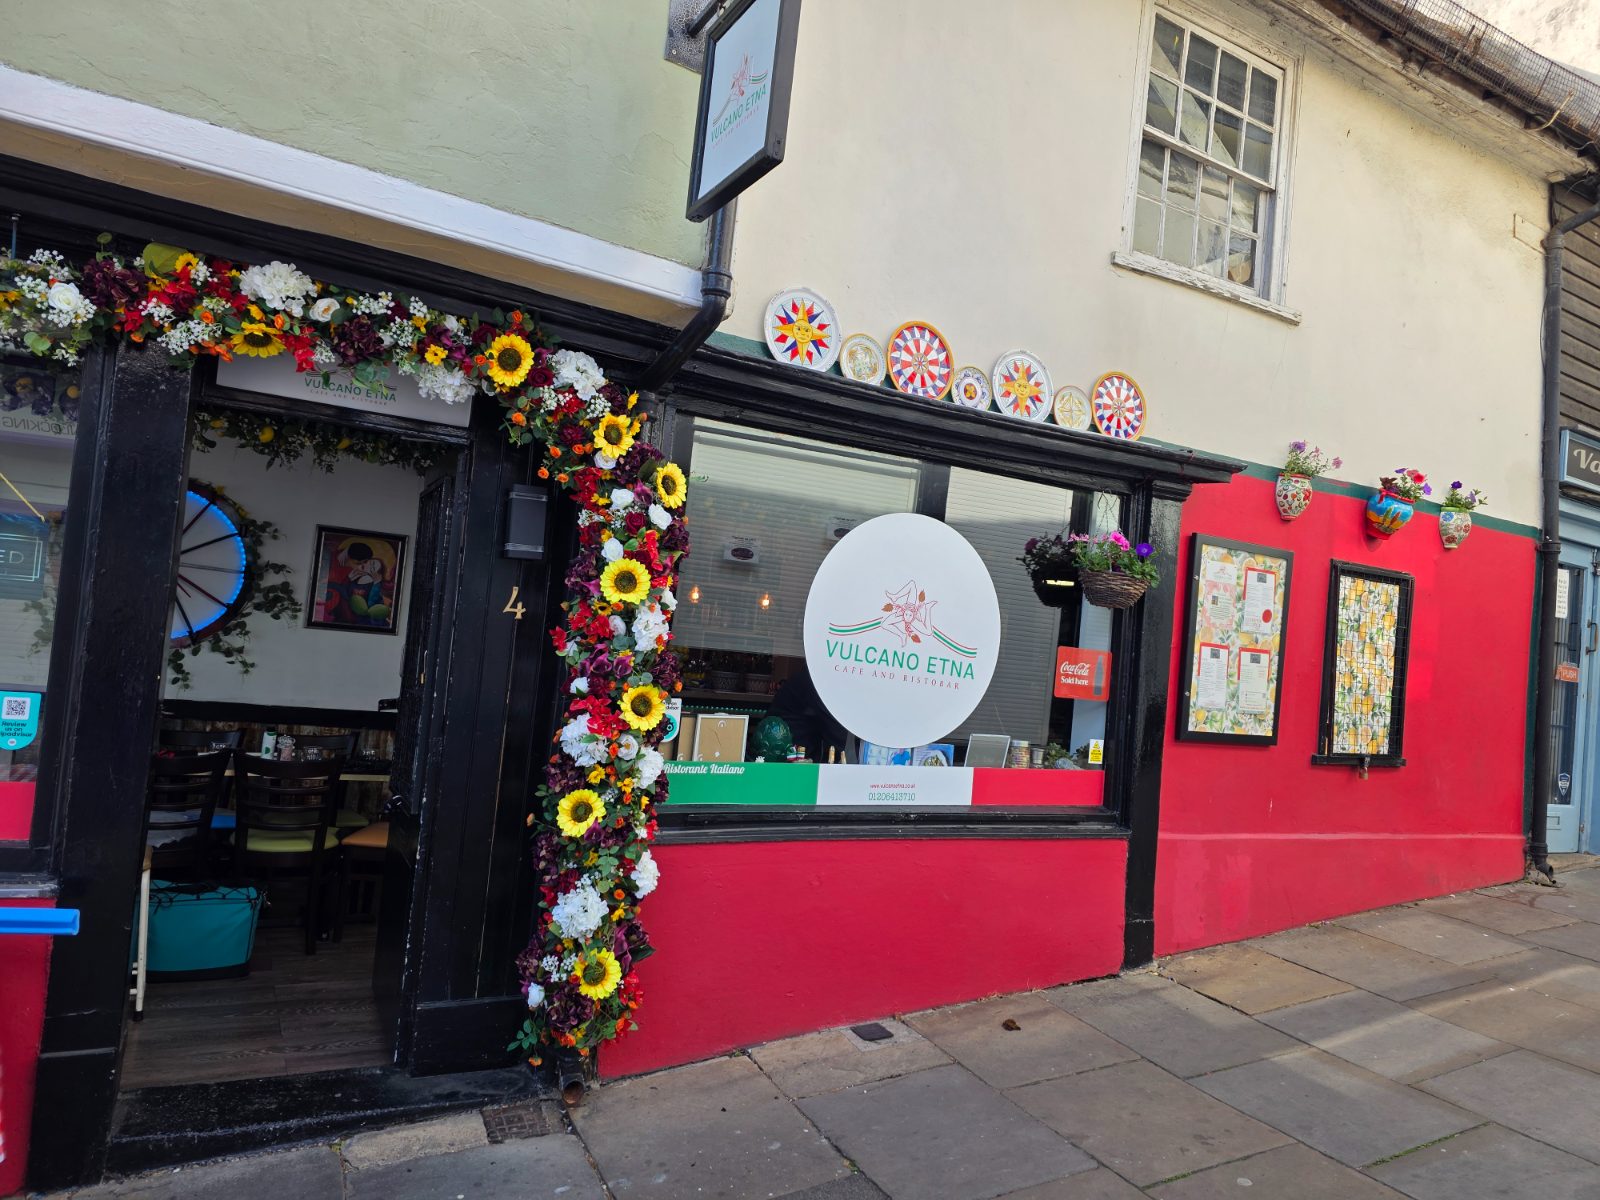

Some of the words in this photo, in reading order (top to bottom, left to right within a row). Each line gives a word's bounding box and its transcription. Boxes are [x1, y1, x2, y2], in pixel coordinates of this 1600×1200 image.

[711, 104, 743, 143] VULCANO
[745, 83, 767, 112] ETNA
[304, 377, 361, 395] VULCANO
[502, 586, 527, 620] 4
[826, 639, 920, 671] VULCANO
[926, 656, 975, 680] ETNA
[1060, 660, 1091, 677] Coca-Cola
[834, 664, 865, 676] CAFE
[871, 670, 896, 680] AND
[903, 674, 960, 690] RISTOBAR
[1060, 675, 1074, 685] Sold
[1074, 676, 1089, 686] here
[1562, 671, 1577, 679] PUSH
[663, 762, 708, 775] Ristorante
[710, 763, 745, 775] Italiano
